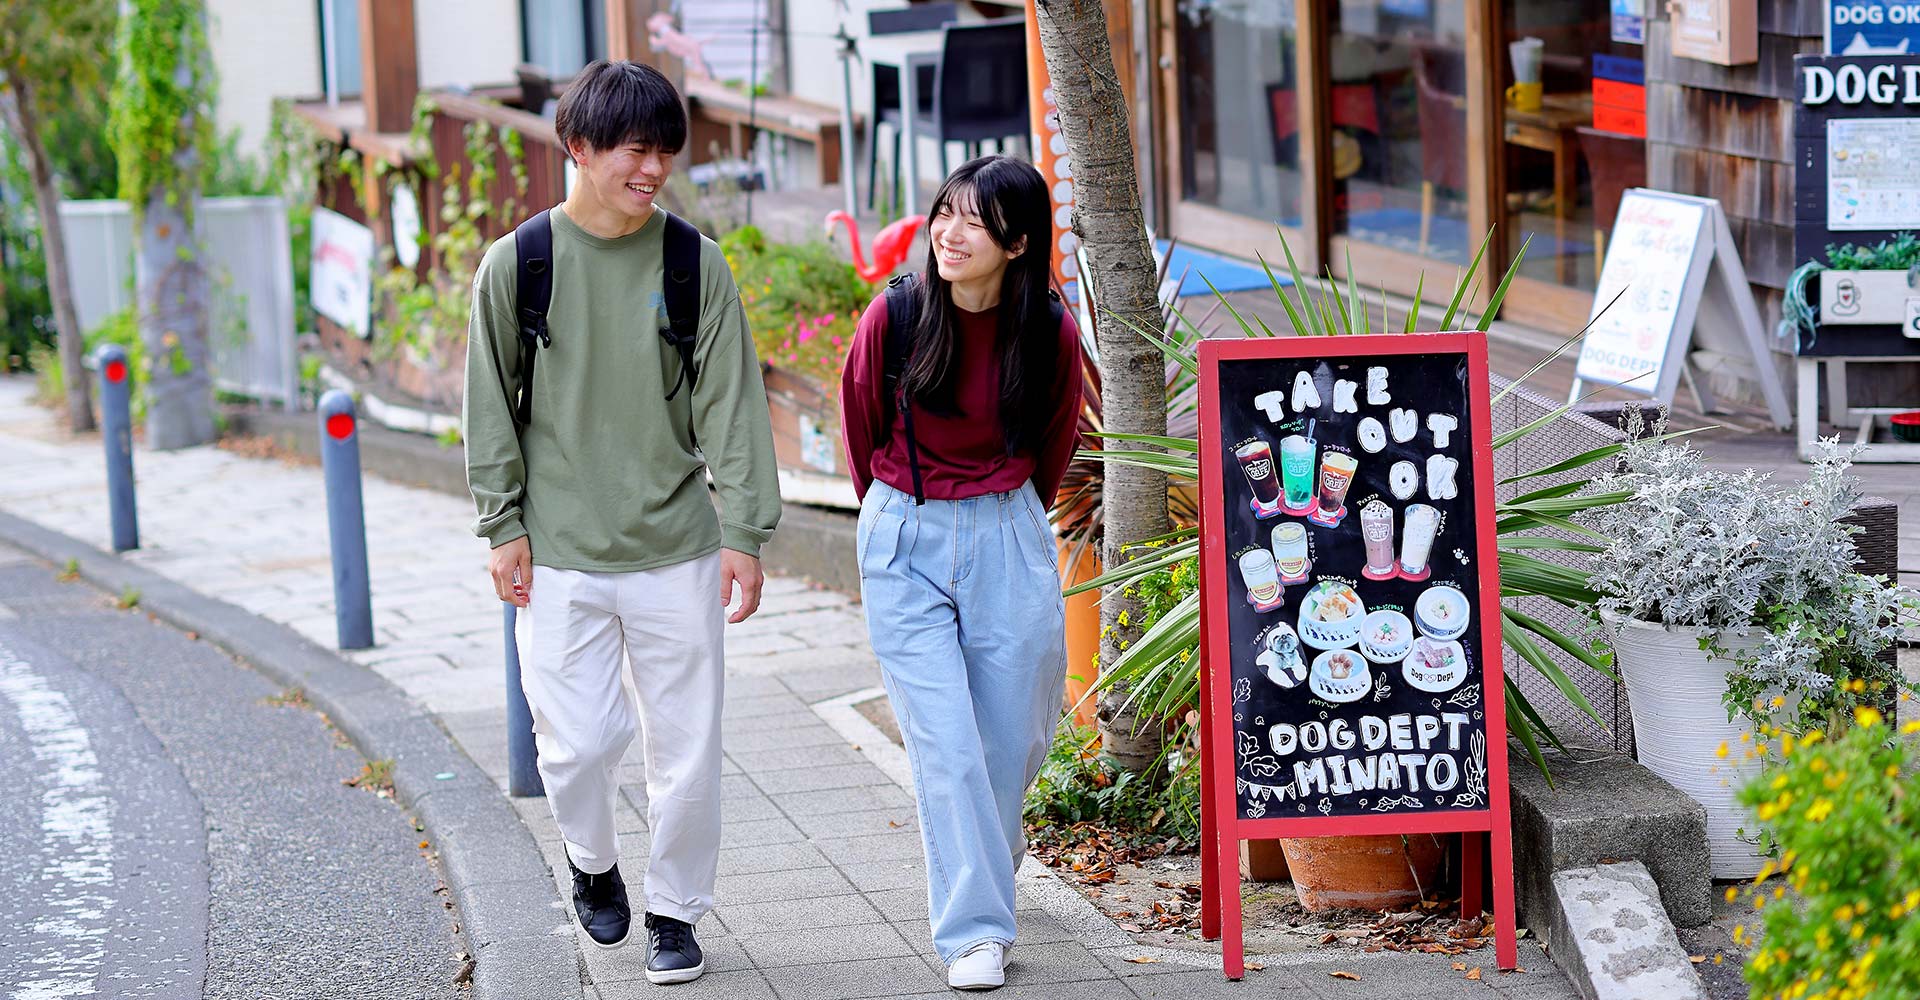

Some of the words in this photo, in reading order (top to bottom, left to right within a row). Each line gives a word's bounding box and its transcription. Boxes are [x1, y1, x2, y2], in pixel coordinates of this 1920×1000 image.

[1834, 5, 1883, 25] DOG
[1888, 5, 1920, 25] OK
[1802, 63, 1898, 105] DOG
[1583, 346, 1615, 366] DOG
[1619, 355, 1658, 372] DEPT
[1254, 366, 1391, 423] TAKE
[1357, 407, 1458, 453] OUT
[1388, 453, 1458, 500] OK
[1411, 668, 1423, 682] Dog
[1437, 671, 1454, 682] Dept
[1268, 718, 1357, 756] DOG
[1359, 712, 1470, 752] DEPT
[1293, 753, 1460, 798] MINATO
